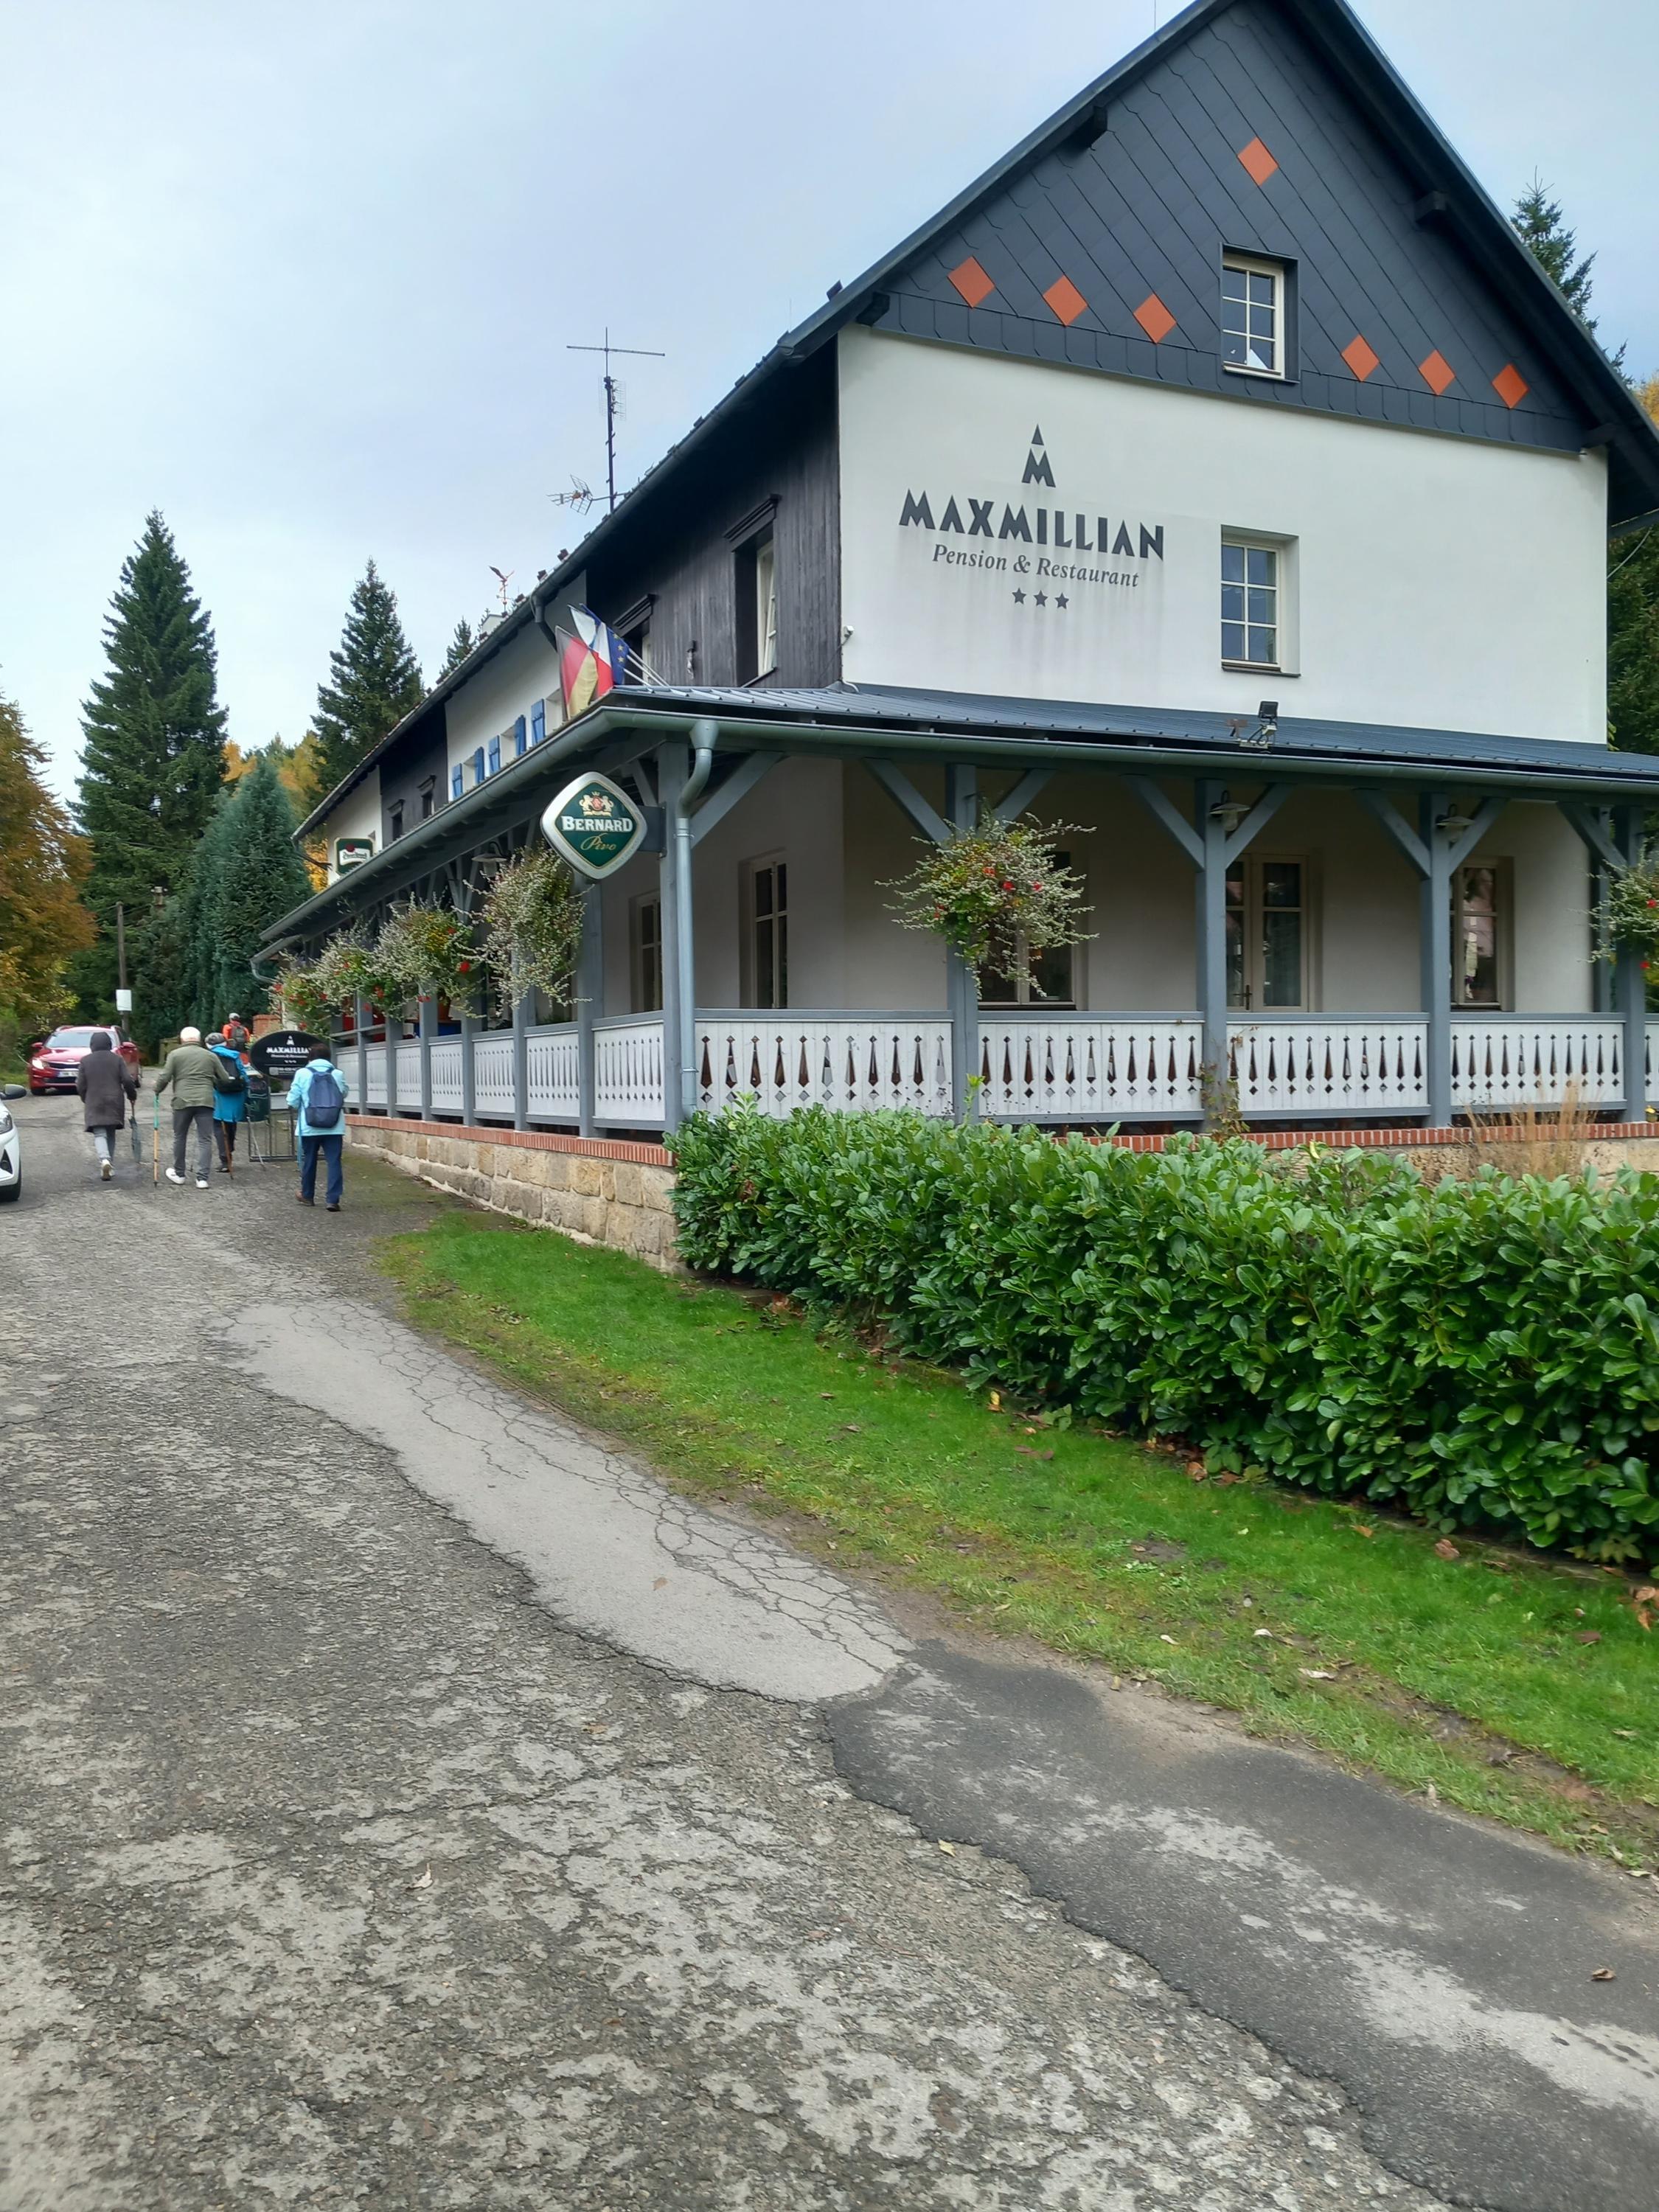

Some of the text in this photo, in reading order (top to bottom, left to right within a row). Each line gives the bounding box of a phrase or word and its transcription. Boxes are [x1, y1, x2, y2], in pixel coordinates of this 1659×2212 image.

[898, 488, 1164, 561] MAXMILLIAN
[932, 543, 1139, 588] Pension & Restaurant
[560, 815, 633, 832] BERNARD
[580, 832, 617, 851] Pivo
